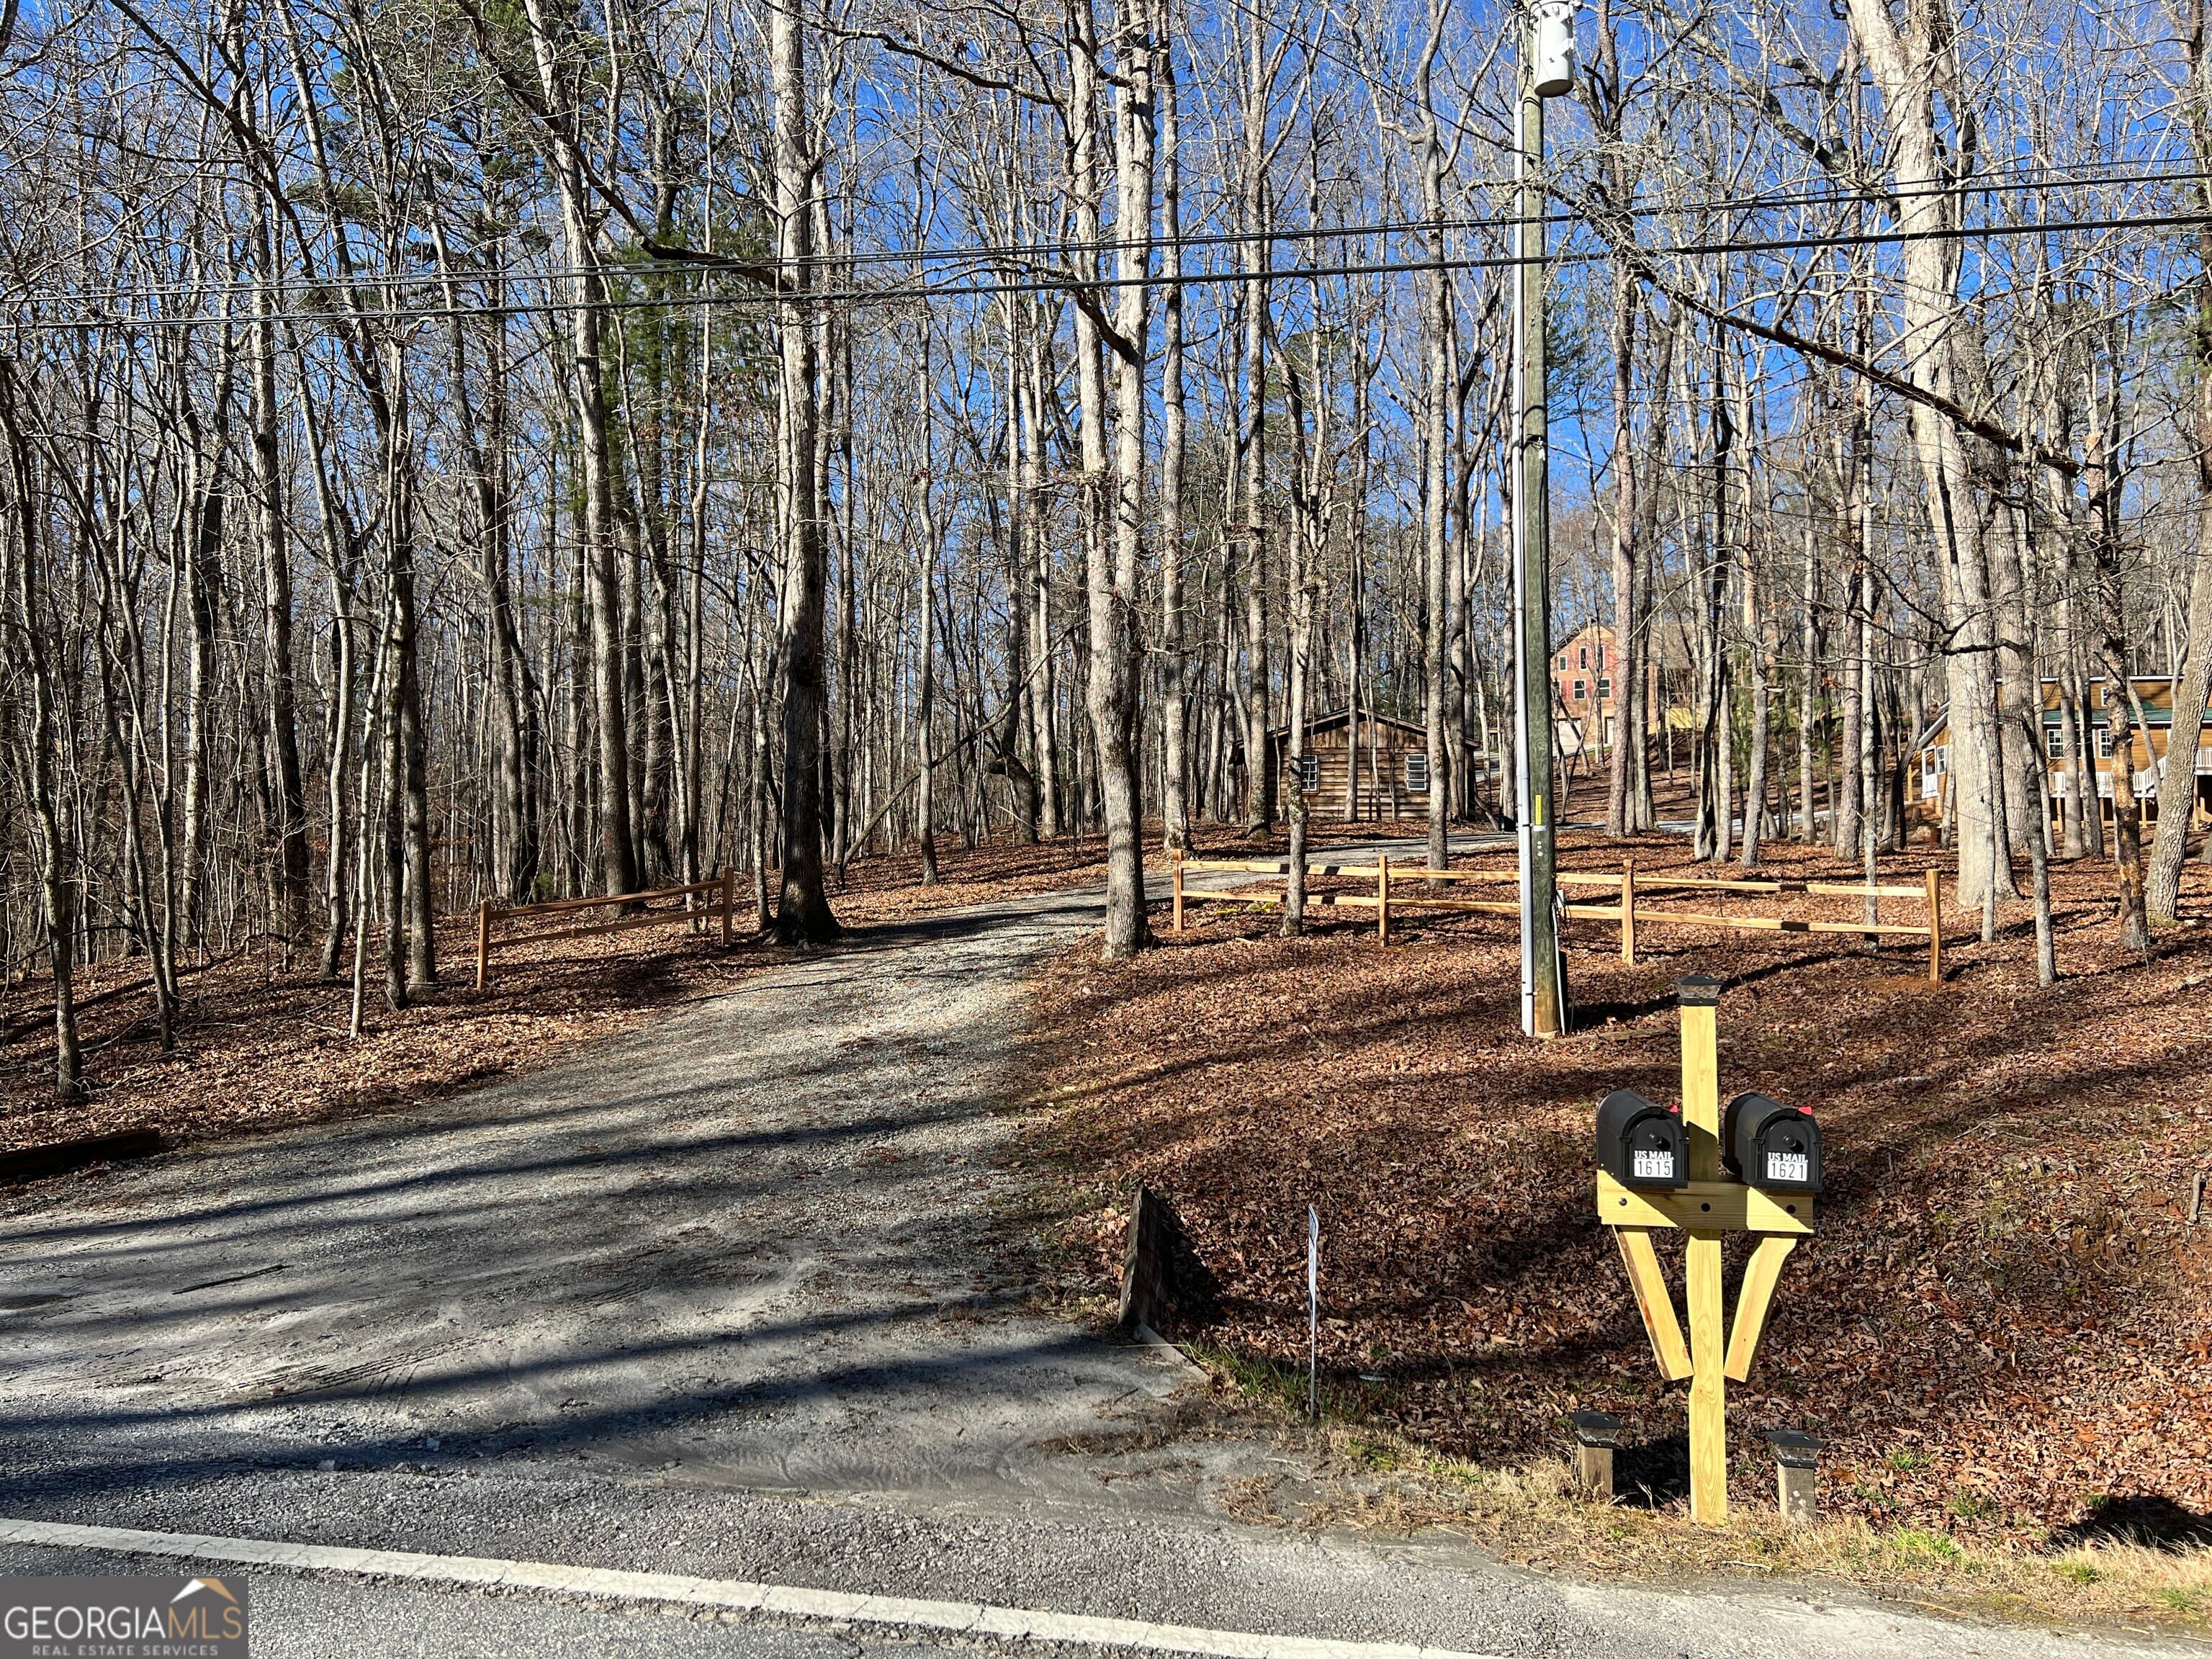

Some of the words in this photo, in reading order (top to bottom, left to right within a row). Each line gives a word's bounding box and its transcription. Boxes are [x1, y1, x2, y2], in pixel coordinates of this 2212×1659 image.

[1649, 1151, 1674, 1160] MAIL
[1768, 1152, 1781, 1161] US
[1782, 1153, 1808, 1163] MAIL
[1638, 1161, 1671, 1176] 1615
[1771, 1163, 1804, 1179] 1621
